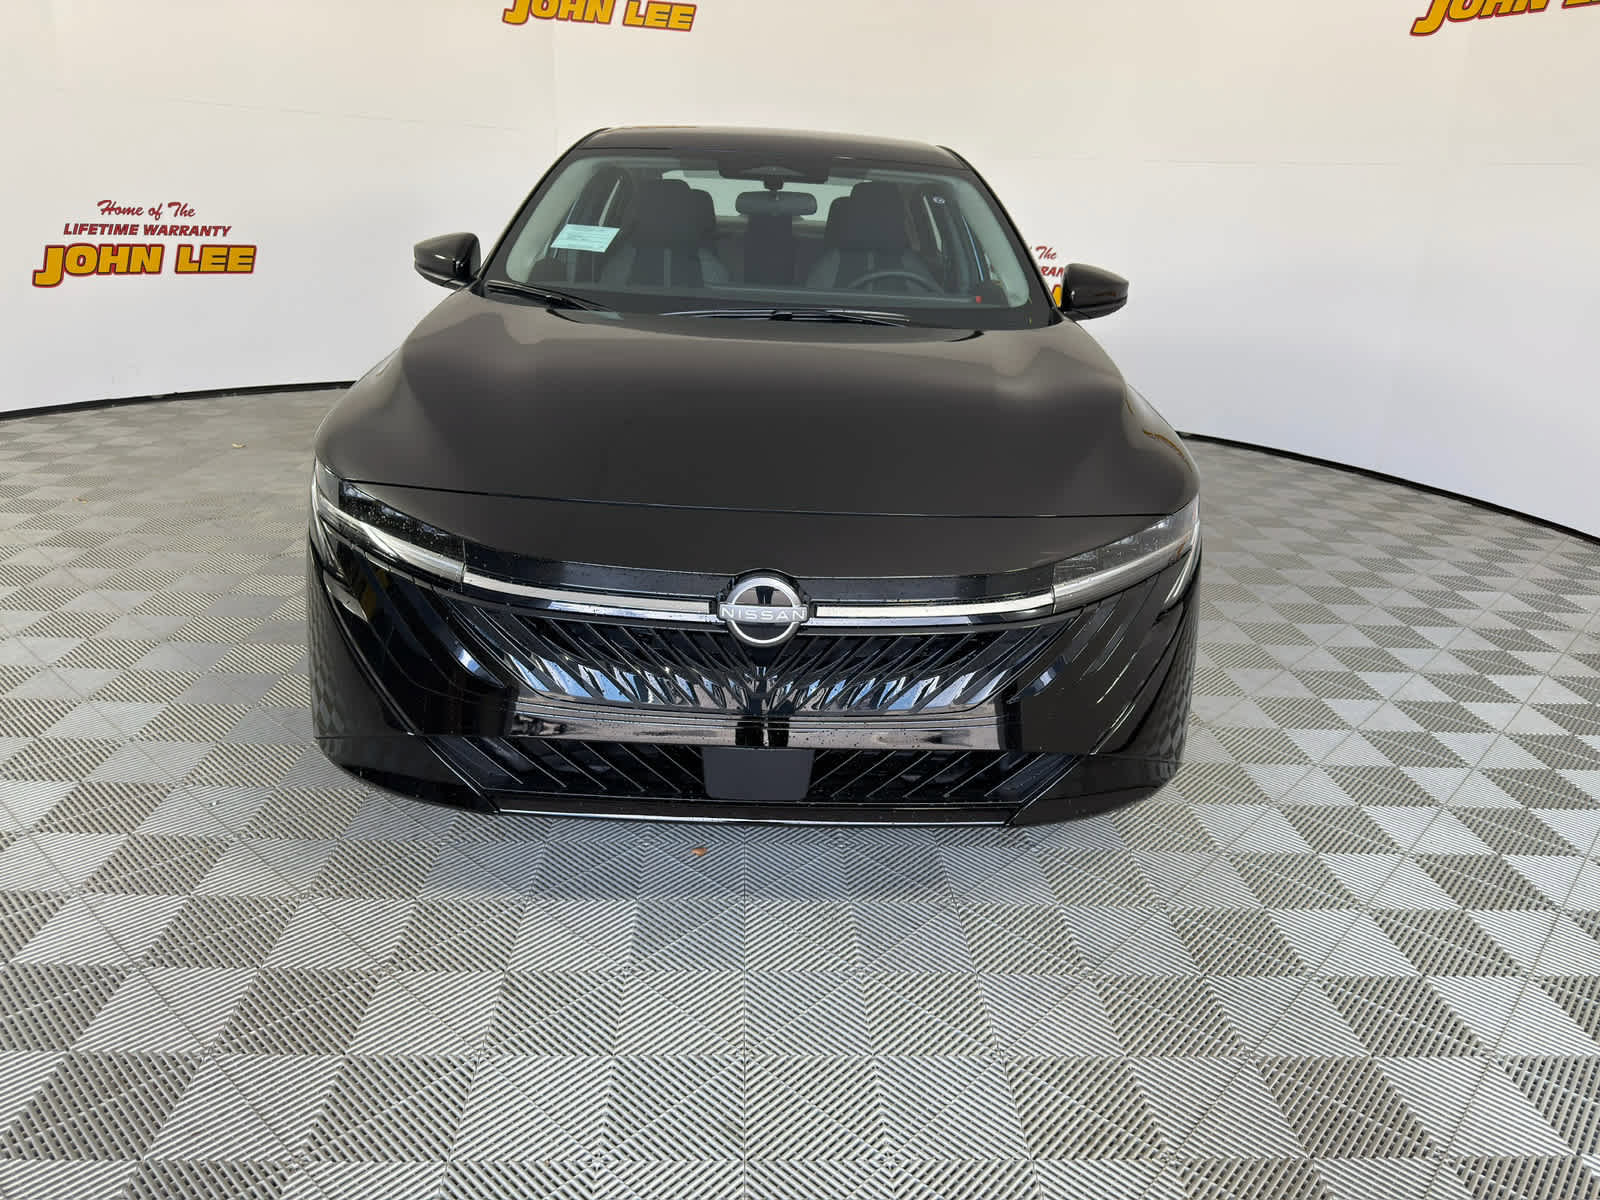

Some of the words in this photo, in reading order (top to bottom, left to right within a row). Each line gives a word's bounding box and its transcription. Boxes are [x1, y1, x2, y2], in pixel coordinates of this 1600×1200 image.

[502, 0, 616, 25] JOHN
[622, 0, 697, 32] LEE
[97, 200, 144, 217] Home
[148, 203, 163, 221] of
[168, 202, 196, 218] The
[63, 223, 139, 236] LIFETIME
[143, 224, 232, 237] WARRANTY
[1035, 246, 1057, 260] The
[32, 242, 165, 288] JOHN
[174, 244, 257, 275] LEE
[721, 606, 806, 621] NISSAN
